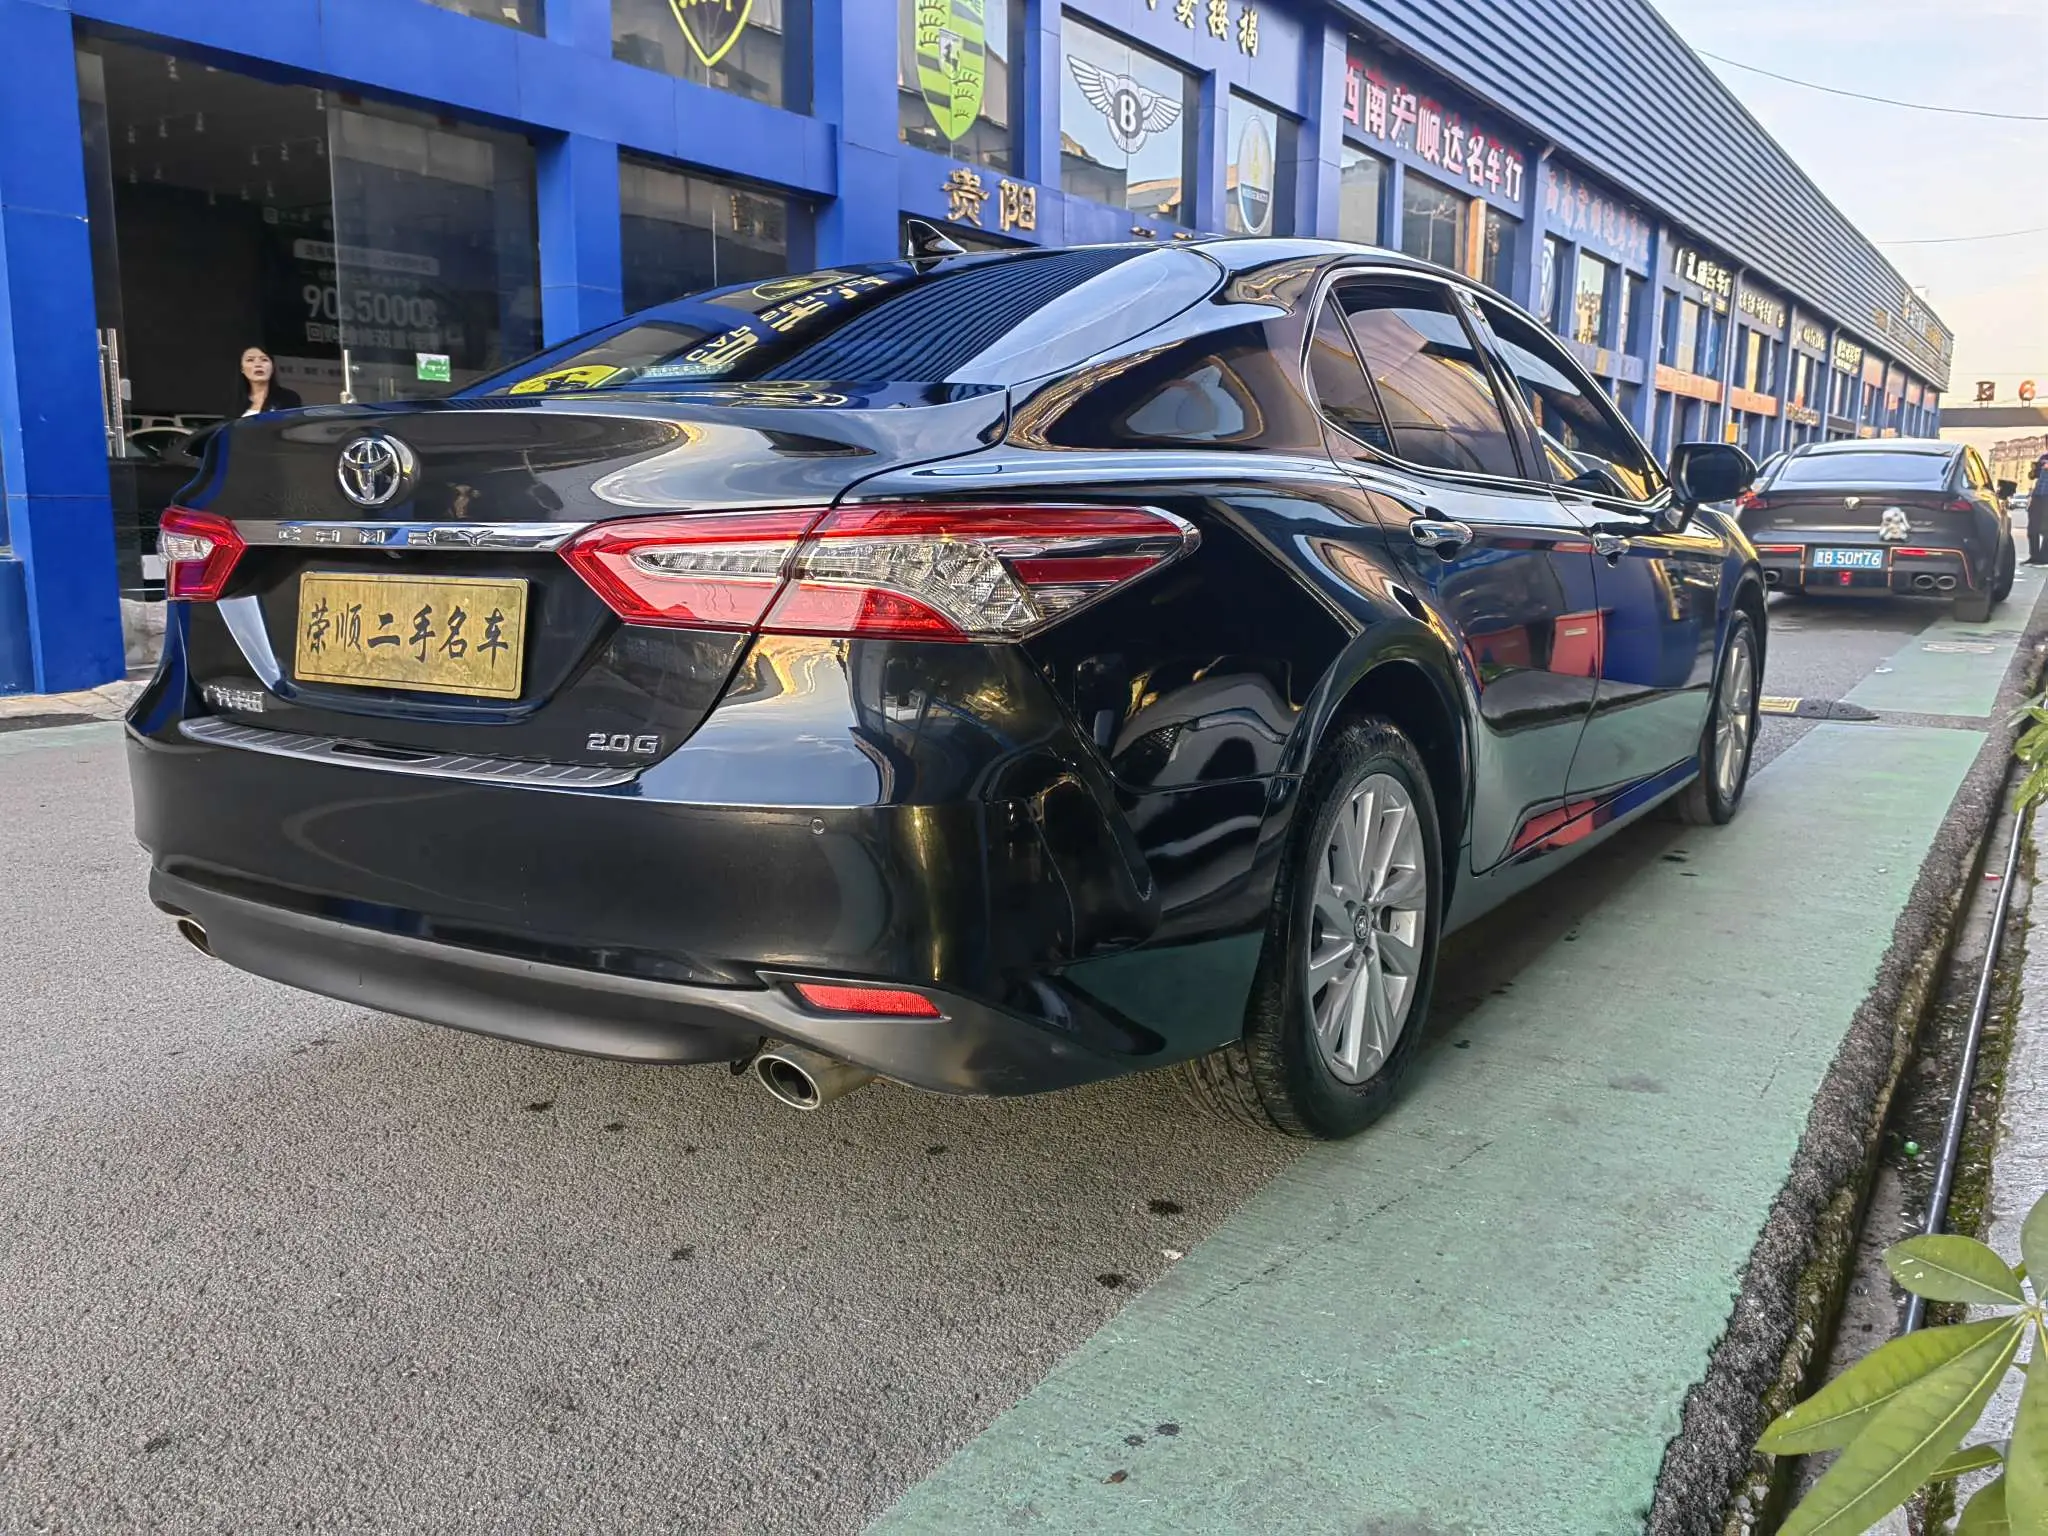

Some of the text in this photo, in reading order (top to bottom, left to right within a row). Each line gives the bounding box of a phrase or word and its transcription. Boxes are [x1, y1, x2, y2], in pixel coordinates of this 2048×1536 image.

[1119, 94, 1138, 133] B
[941, 166, 1037, 232] 贵阳
[278, 526, 494, 547] CAMRY
[306, 597, 509, 671] 荣顺二手名车
[586, 732, 659, 754] 2.0G
